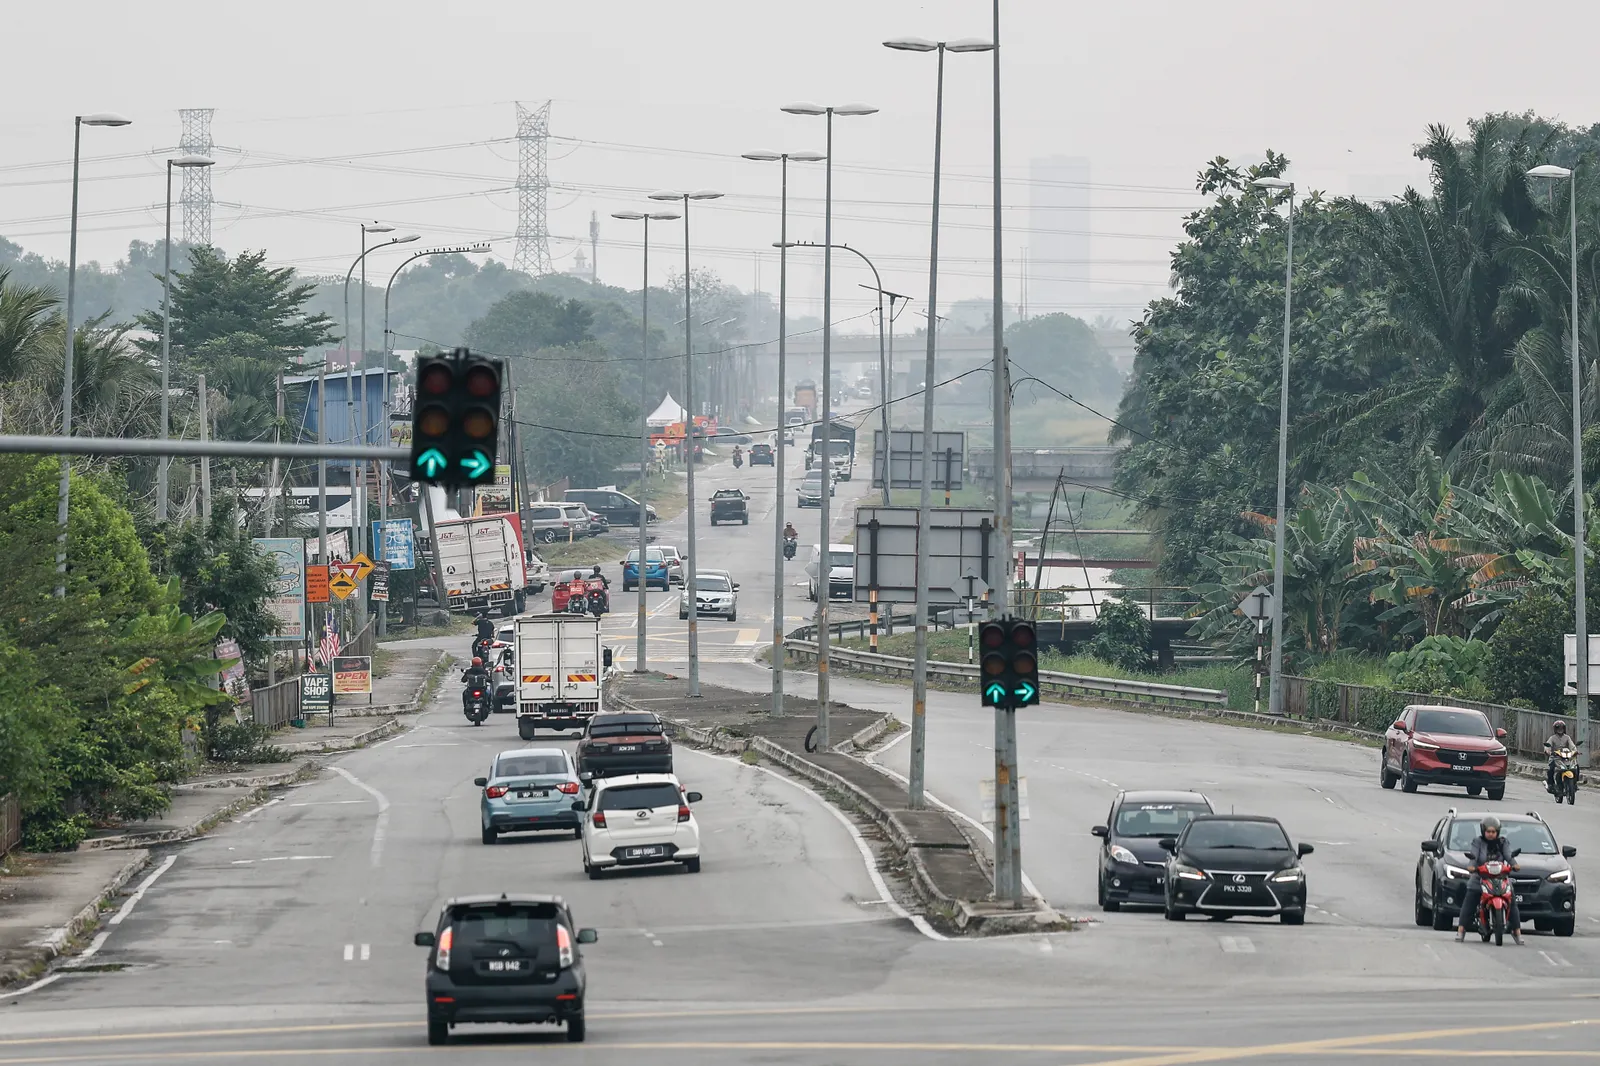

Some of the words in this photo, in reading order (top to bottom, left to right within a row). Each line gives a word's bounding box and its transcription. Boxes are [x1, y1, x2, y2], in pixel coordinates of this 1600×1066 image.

[282, 582, 300, 590] Spa
[304, 678, 328, 686] VAPE
[304, 686, 328, 696] SHOP
